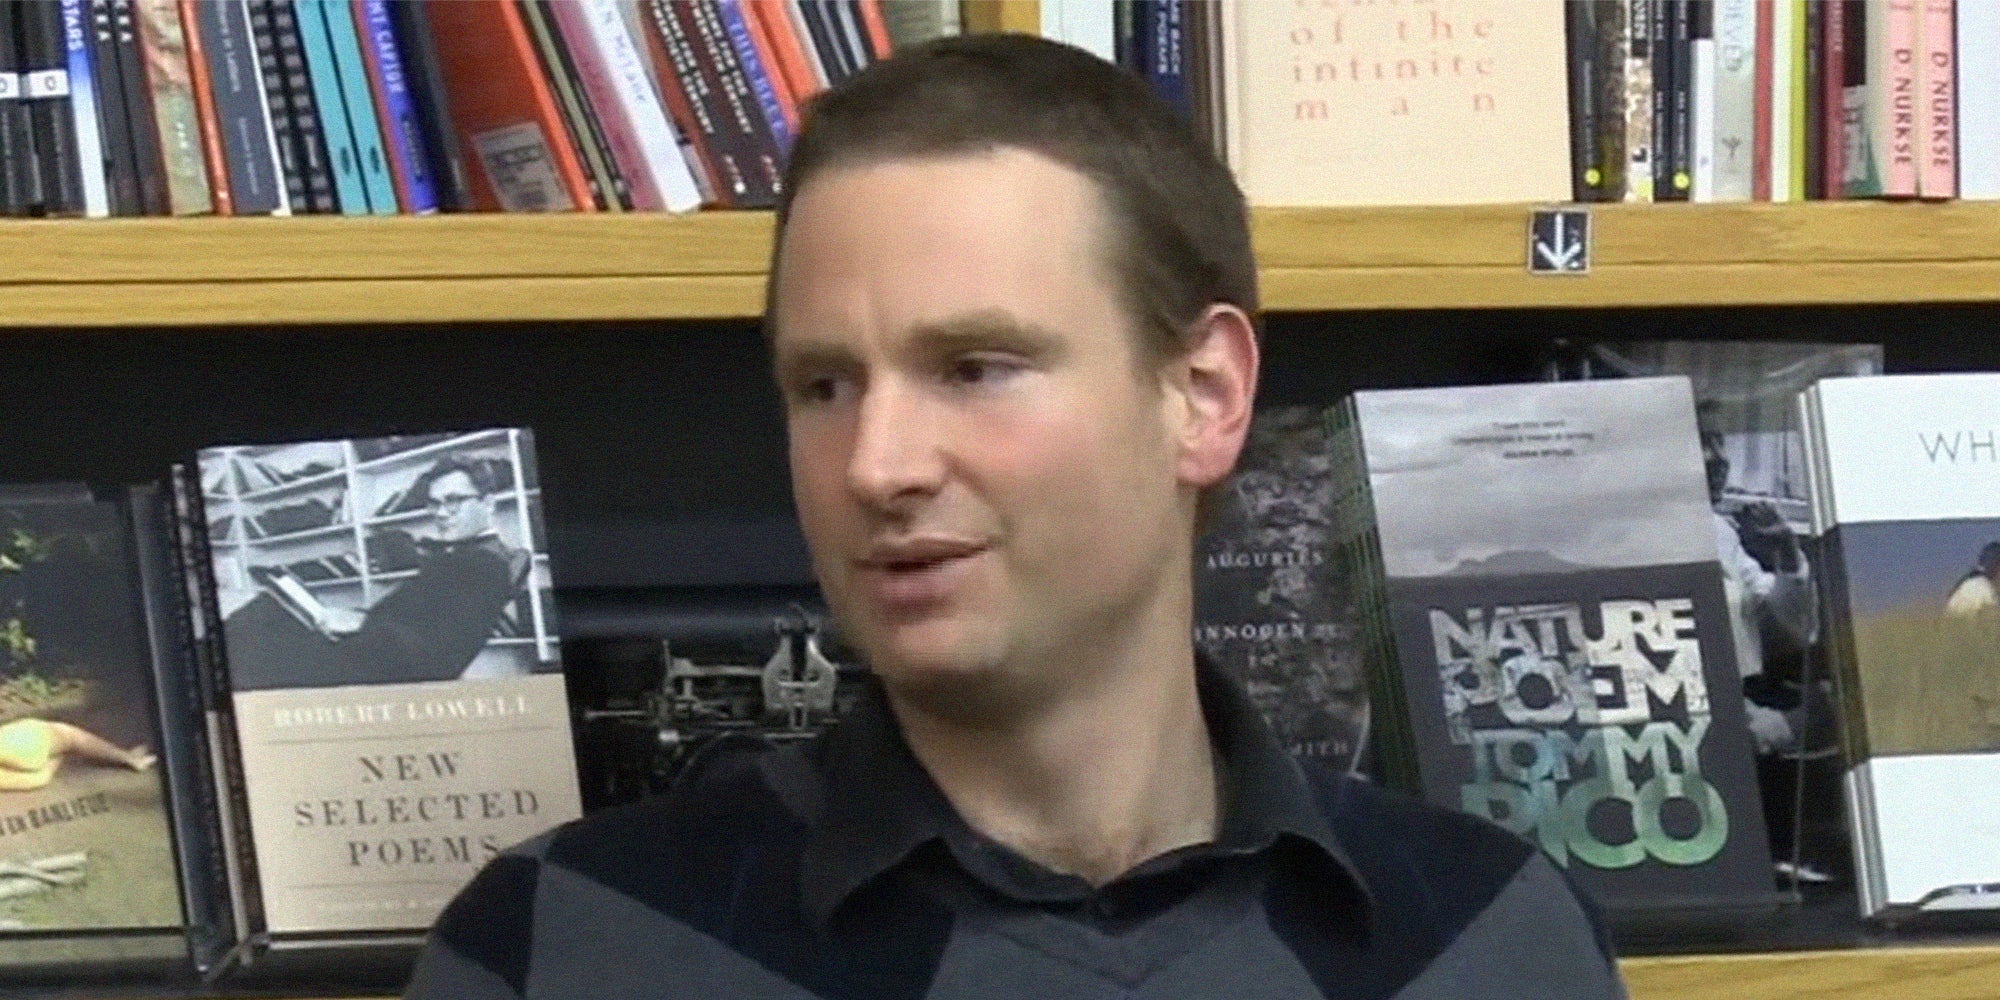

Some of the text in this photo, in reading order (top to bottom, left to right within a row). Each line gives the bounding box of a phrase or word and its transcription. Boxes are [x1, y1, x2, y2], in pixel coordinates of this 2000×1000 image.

[1397, 10, 1493, 42] the
[1894, 77, 1913, 165] NURKSE
[1932, 80, 1950, 167] NURKSE
[1207, 551, 1324, 569] AUGURIES
[1429, 598, 1697, 662] NATURE
[274, 695, 531, 727] ROBERT LOWELL
[1438, 651, 1712, 745] POEM
[358, 751, 463, 784] NEW
[1472, 714, 1713, 800] TOMMY
[294, 788, 541, 828] SELECTED
[1460, 774, 1730, 870] PICO
[348, 834, 502, 867] POEMS
